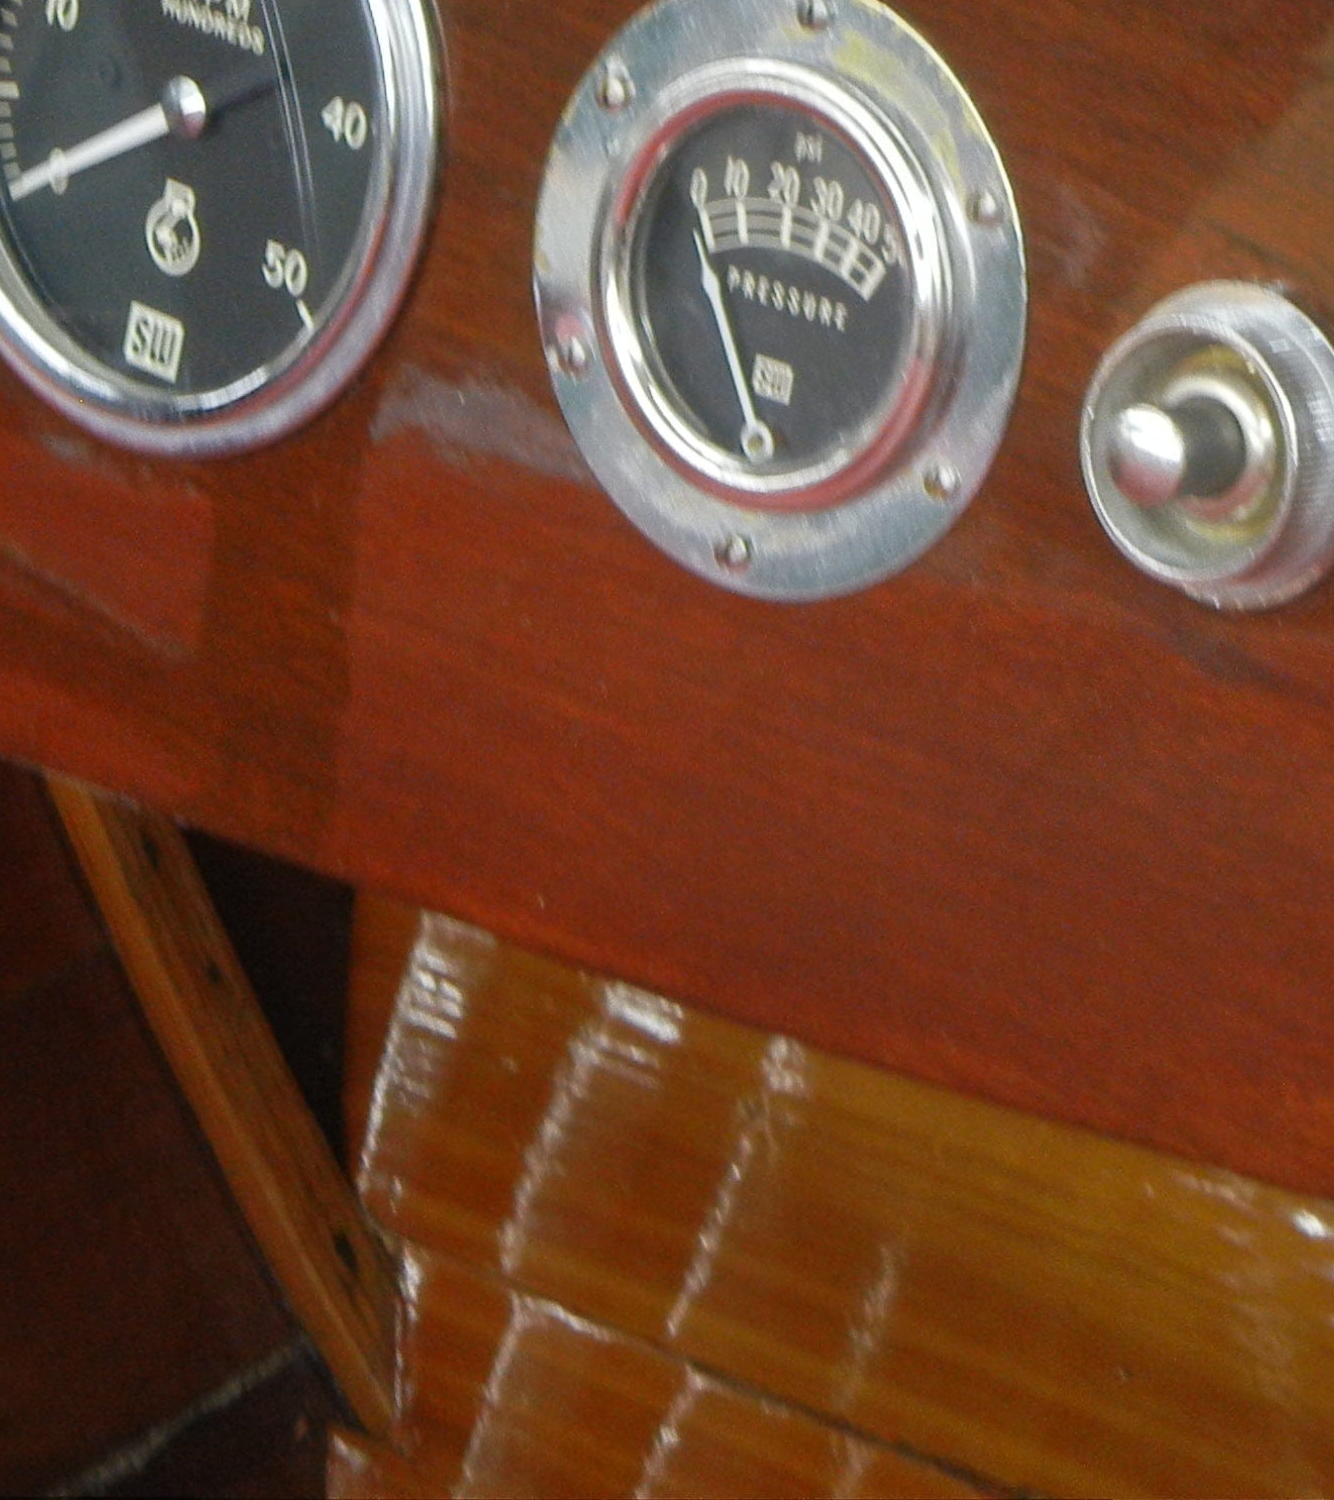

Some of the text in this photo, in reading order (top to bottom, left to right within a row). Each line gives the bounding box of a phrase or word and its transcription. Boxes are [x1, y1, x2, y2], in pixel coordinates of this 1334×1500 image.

[321, 96, 367, 150] 40
[690, 166, 708, 206] 0
[724, 155, 750, 199] 10
[768, 161, 801, 209] 20
[810, 176, 844, 221] 30
[847, 199, 881, 245] 40
[261, 239, 308, 297] 50
[727, 264, 848, 333] PRESSURE
